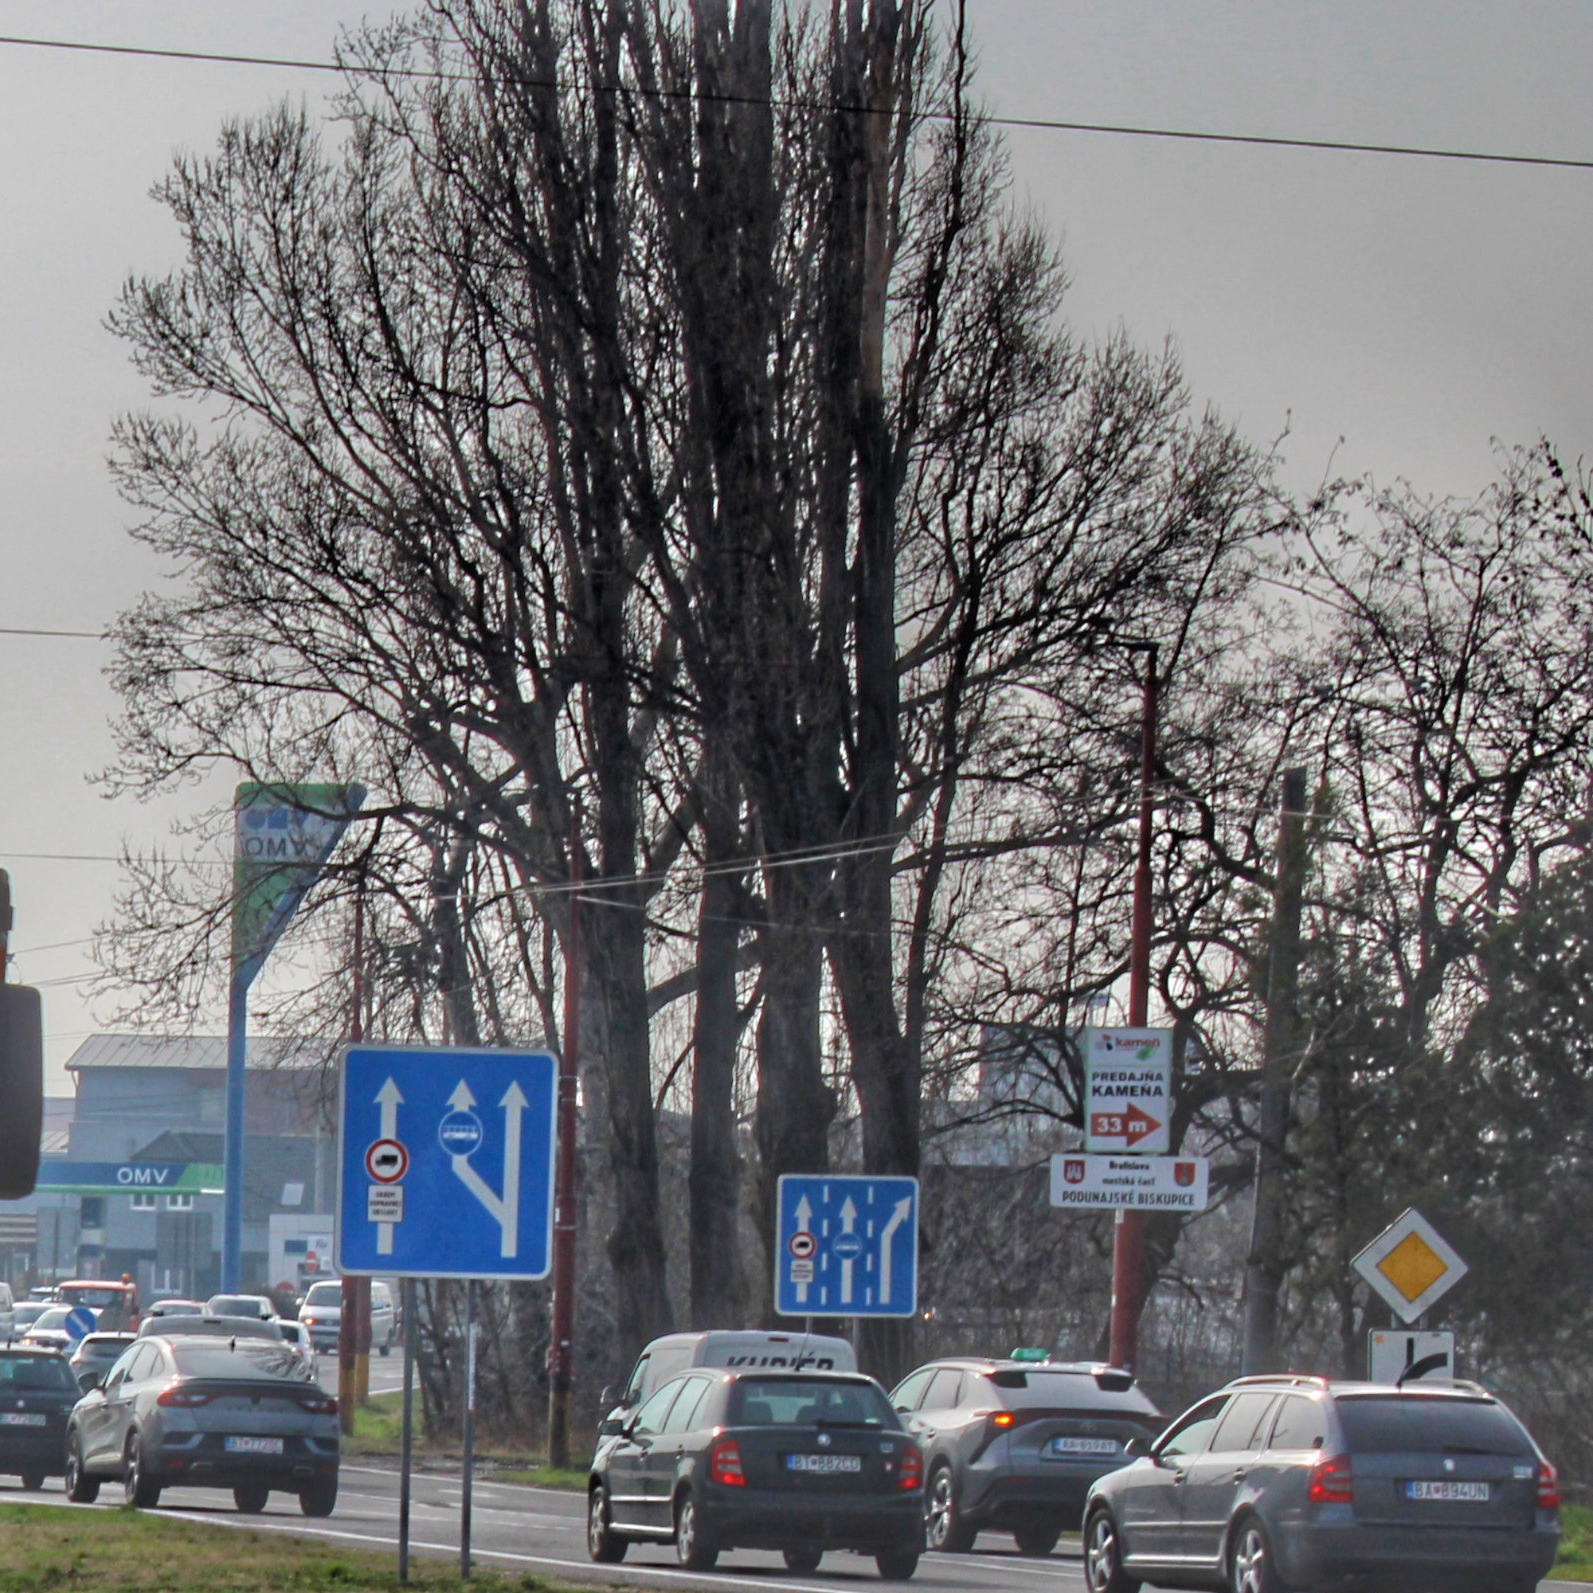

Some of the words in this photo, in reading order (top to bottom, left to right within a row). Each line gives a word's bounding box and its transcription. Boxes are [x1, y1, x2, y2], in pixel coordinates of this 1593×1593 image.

[1092, 1070, 1164, 1082] PREDAJŇA
[1092, 1083, 1163, 1097] KAMEŇA
[1097, 1117, 1122, 1133] 33
[1128, 1120, 1147, 1133] m
[1109, 1160, 1150, 1171] Bratislava
[117, 1167, 169, 1185] OMV
[1062, 1190, 1135, 1205] PODUNAJSKÉ
[1137, 1193, 1195, 1206] BISKUPICE
